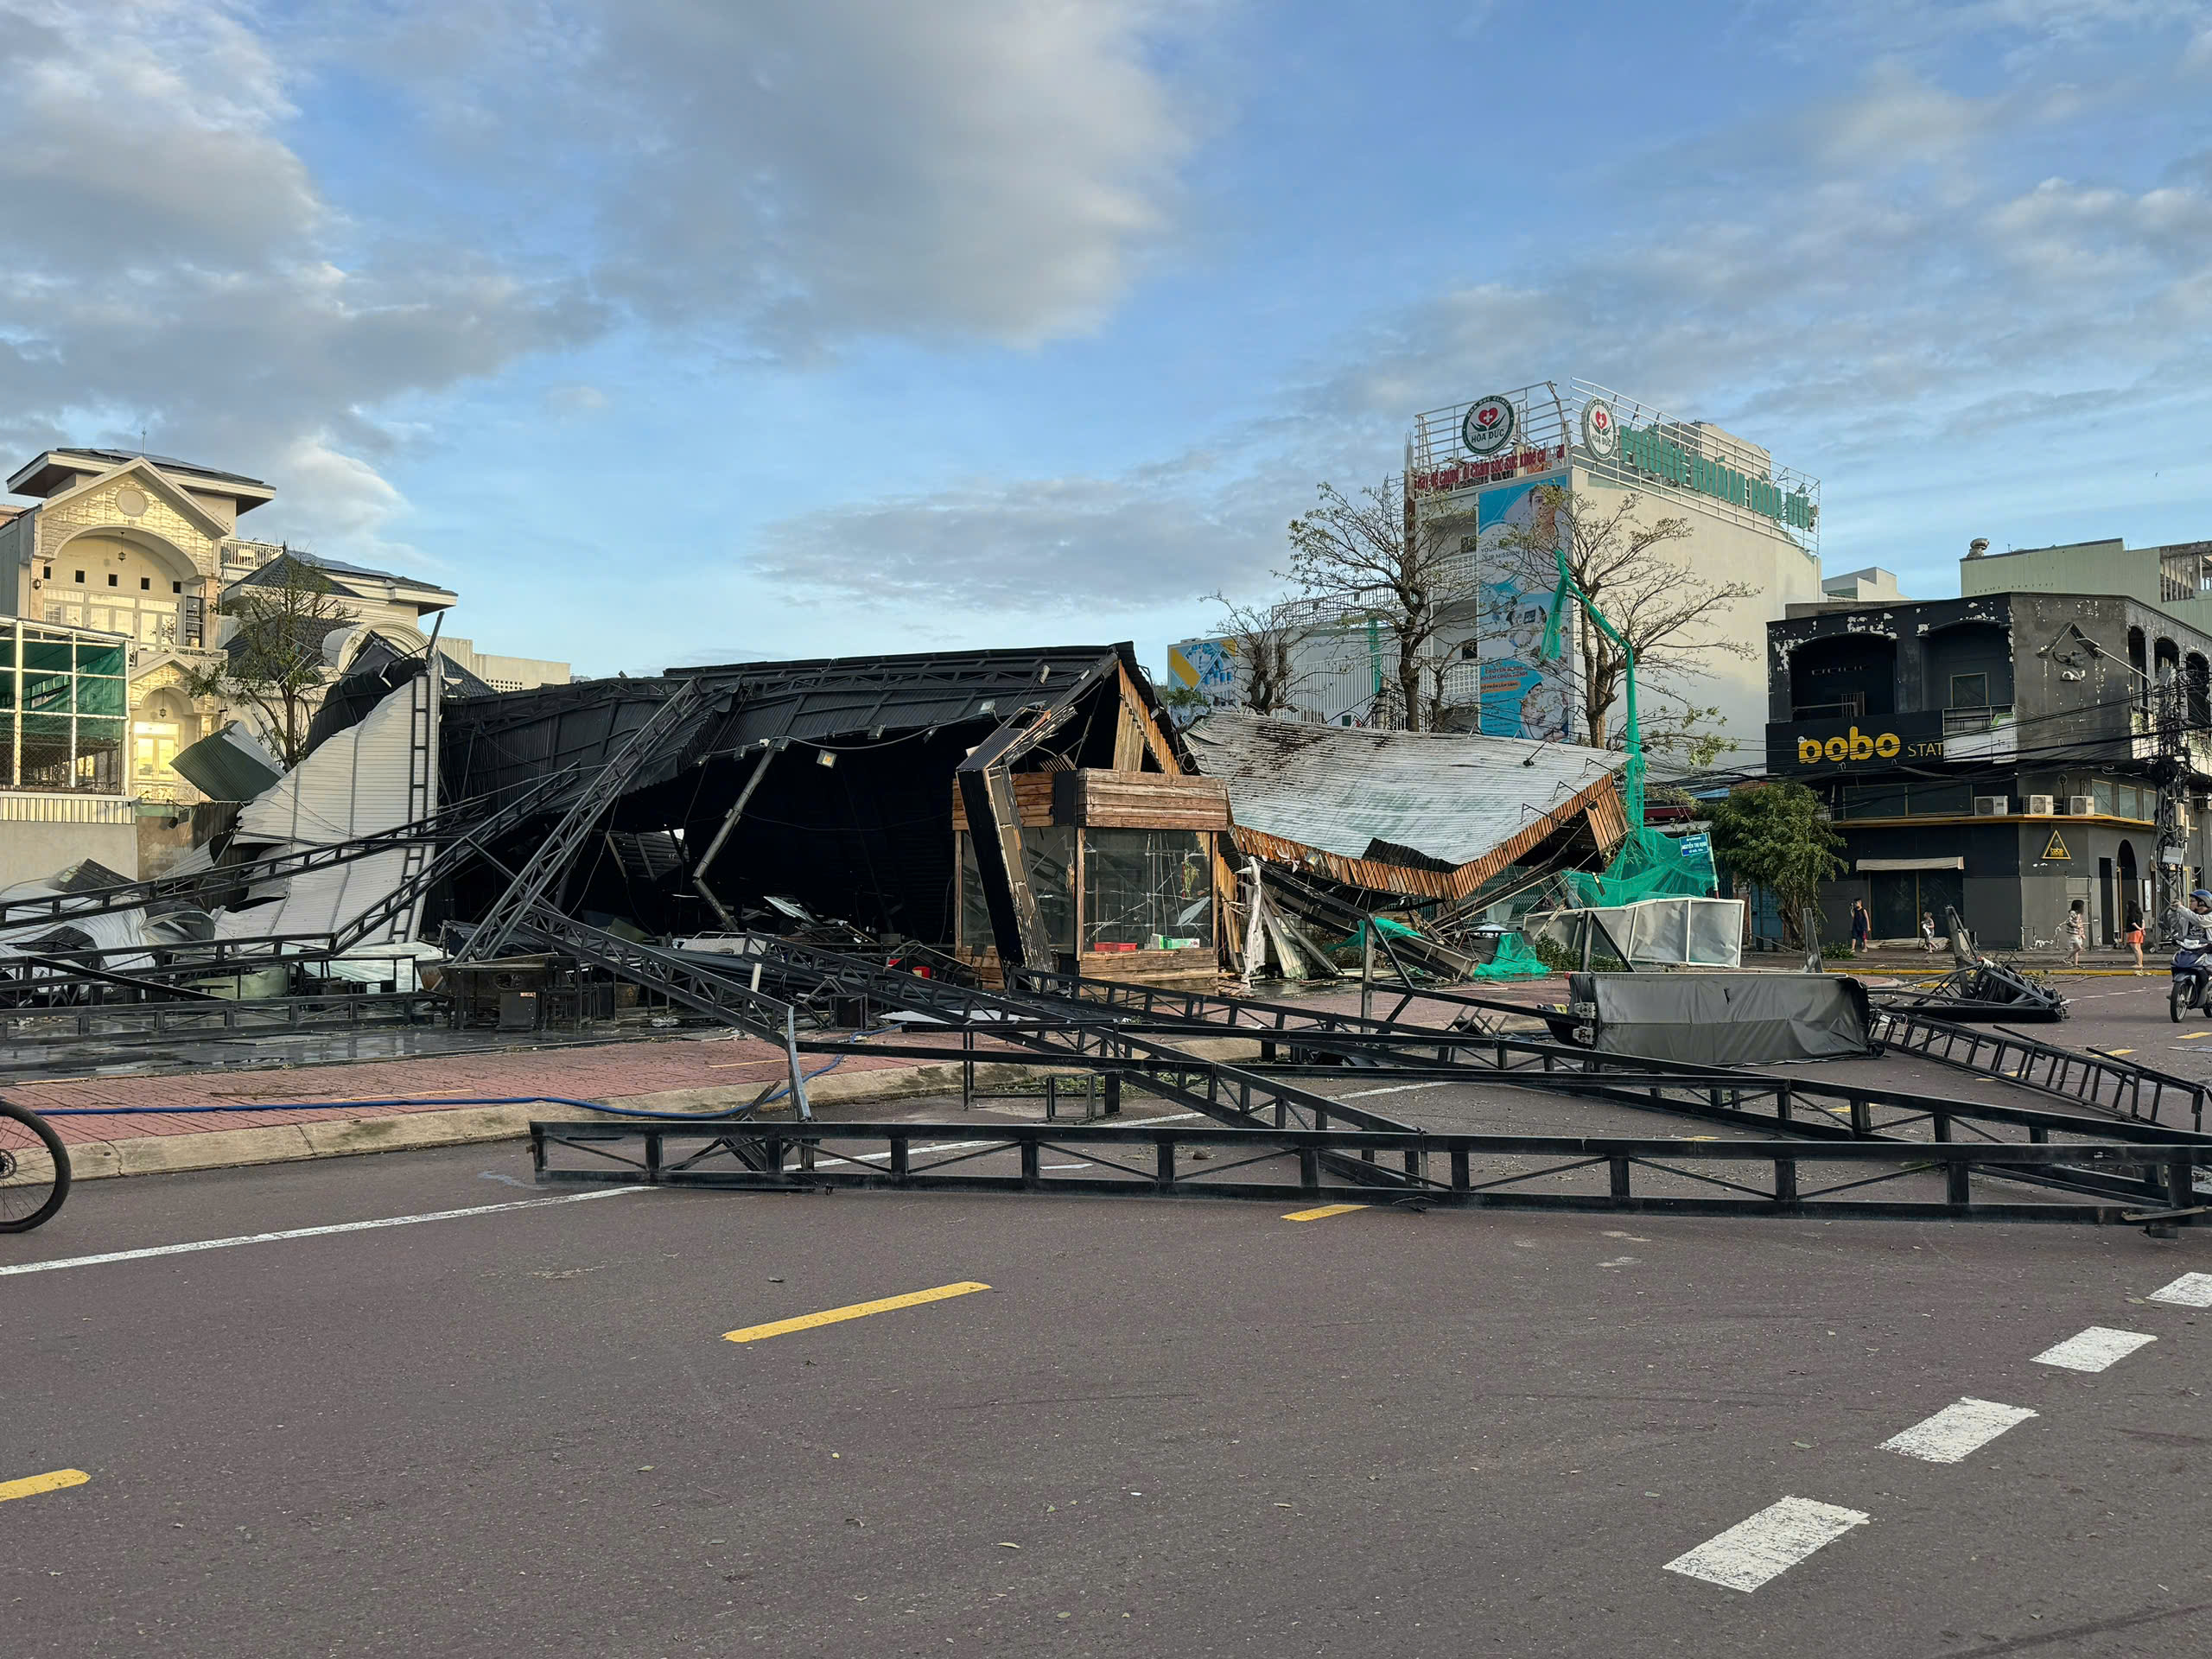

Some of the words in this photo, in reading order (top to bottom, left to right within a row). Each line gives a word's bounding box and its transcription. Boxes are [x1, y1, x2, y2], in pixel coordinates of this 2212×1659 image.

[1618, 424, 1686, 484] PHÒNG
[1689, 454, 1746, 507] KHÁM
[1748, 470, 1783, 519] HÒA
